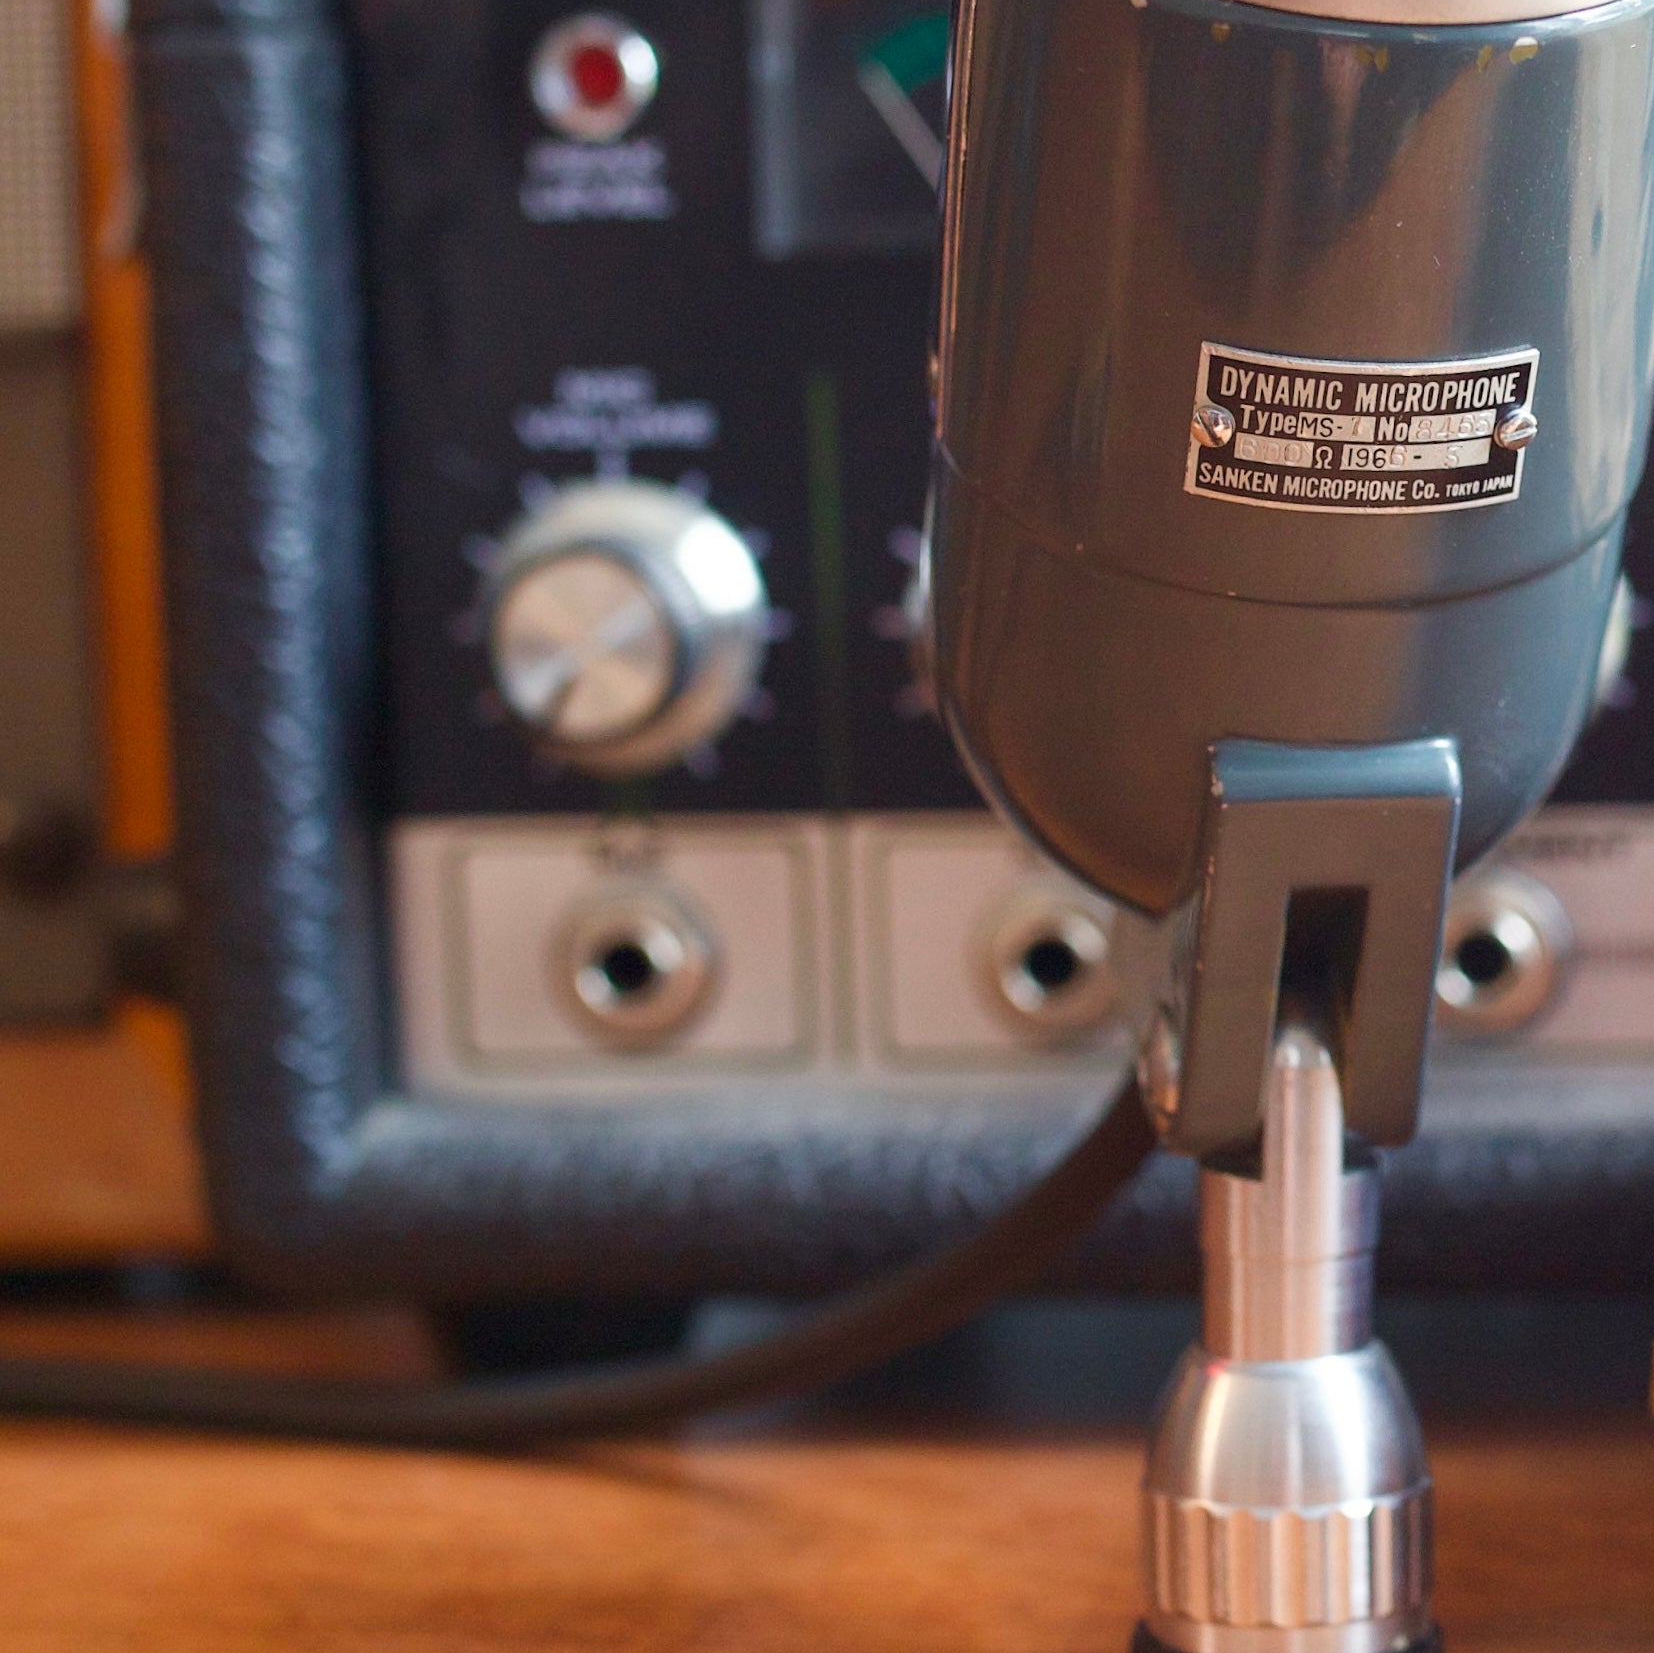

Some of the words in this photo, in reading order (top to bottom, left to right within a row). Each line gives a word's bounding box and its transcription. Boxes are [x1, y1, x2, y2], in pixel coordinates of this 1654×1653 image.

[1220, 365, 1343, 411] DYNAMIC
[1355, 371, 1522, 413] MICROPHONE
[1240, 404, 1297, 436] Type
[1199, 462, 1279, 494] SANKEN
[1283, 474, 1407, 502] MICROPHONE
[1446, 480, 1480, 498] TOKYO
[1482, 474, 1514, 493] JAPAN
